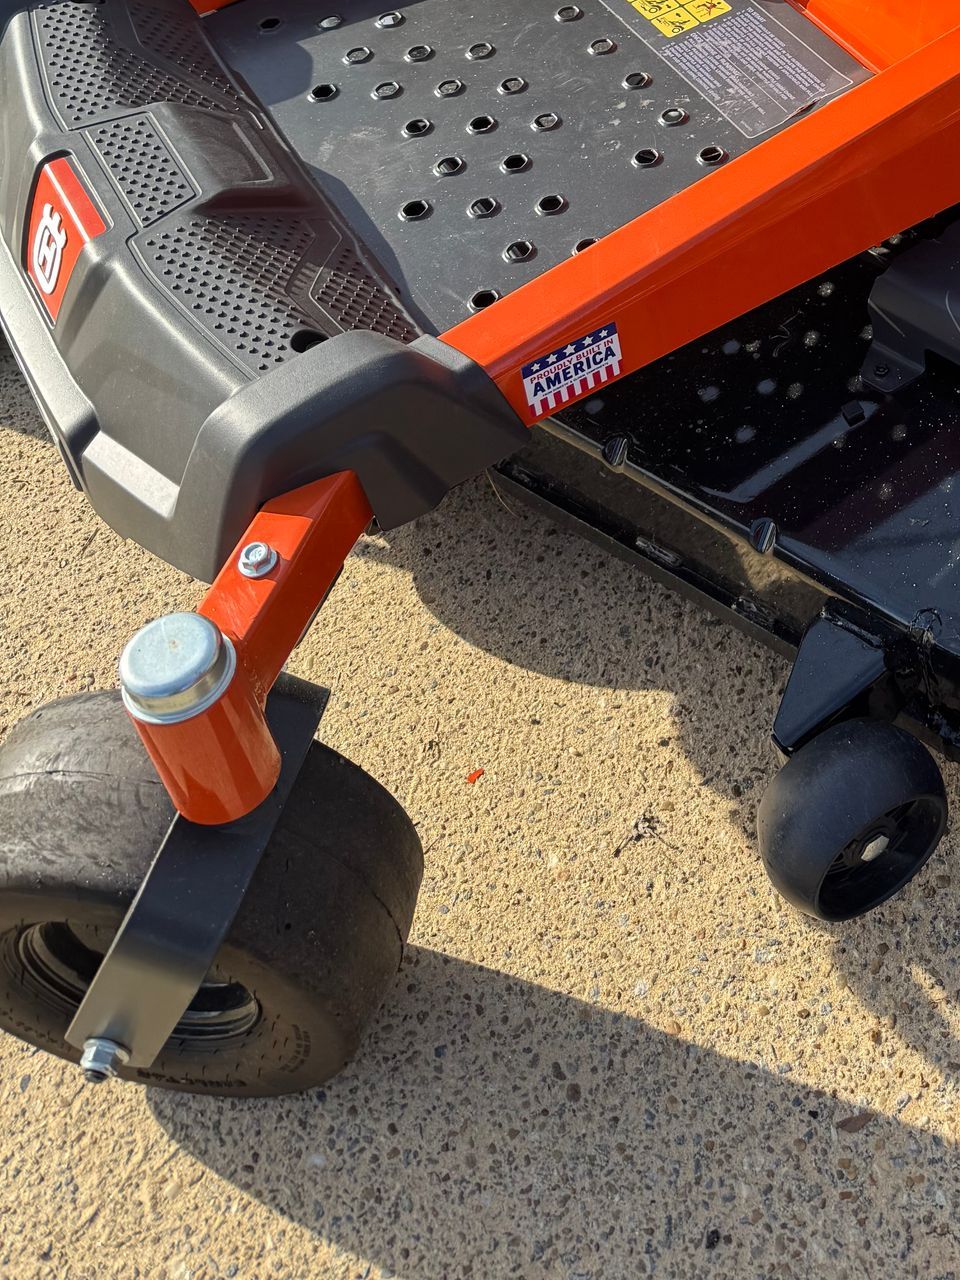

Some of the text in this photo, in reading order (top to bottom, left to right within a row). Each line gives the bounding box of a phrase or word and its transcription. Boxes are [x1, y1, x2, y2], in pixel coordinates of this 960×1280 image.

[530, 358, 573, 384] PROUDLY
[575, 344, 602, 362] BUILT
[603, 338, 614, 348] IN
[533, 346, 616, 397] AMERICA
